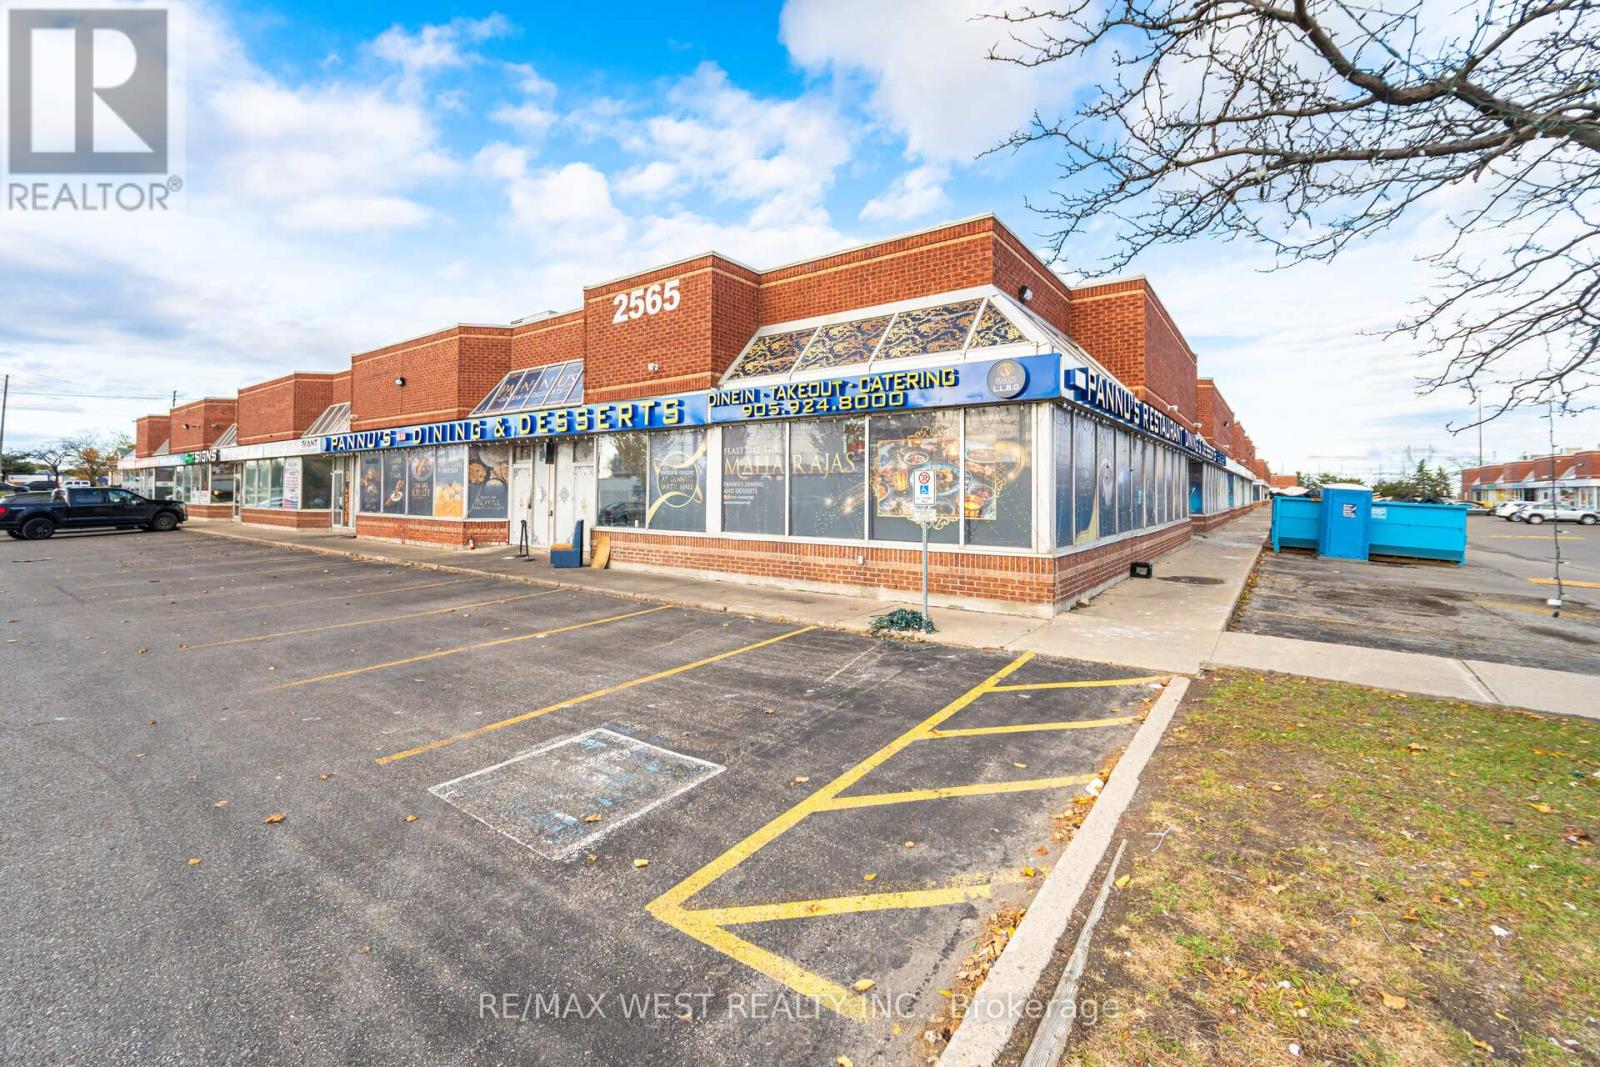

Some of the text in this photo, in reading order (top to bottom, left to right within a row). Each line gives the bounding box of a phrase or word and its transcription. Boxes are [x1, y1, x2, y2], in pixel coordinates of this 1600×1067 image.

[612, 279, 681, 325] 2565
[707, 388, 757, 408] DINEIN
[770, 380, 844, 402] TAKEOUT
[858, 367, 959, 394] CATERING
[742, 389, 904, 418] 905.924.8000
[1087, 366, 1140, 425] PANNU'S
[331, 430, 393, 452] PANNU'S
[413, 420, 482, 445] DINING
[493, 417, 508, 438] &
[519, 399, 682, 436] DESSERTS
[724, 447, 744, 455] FEAST
